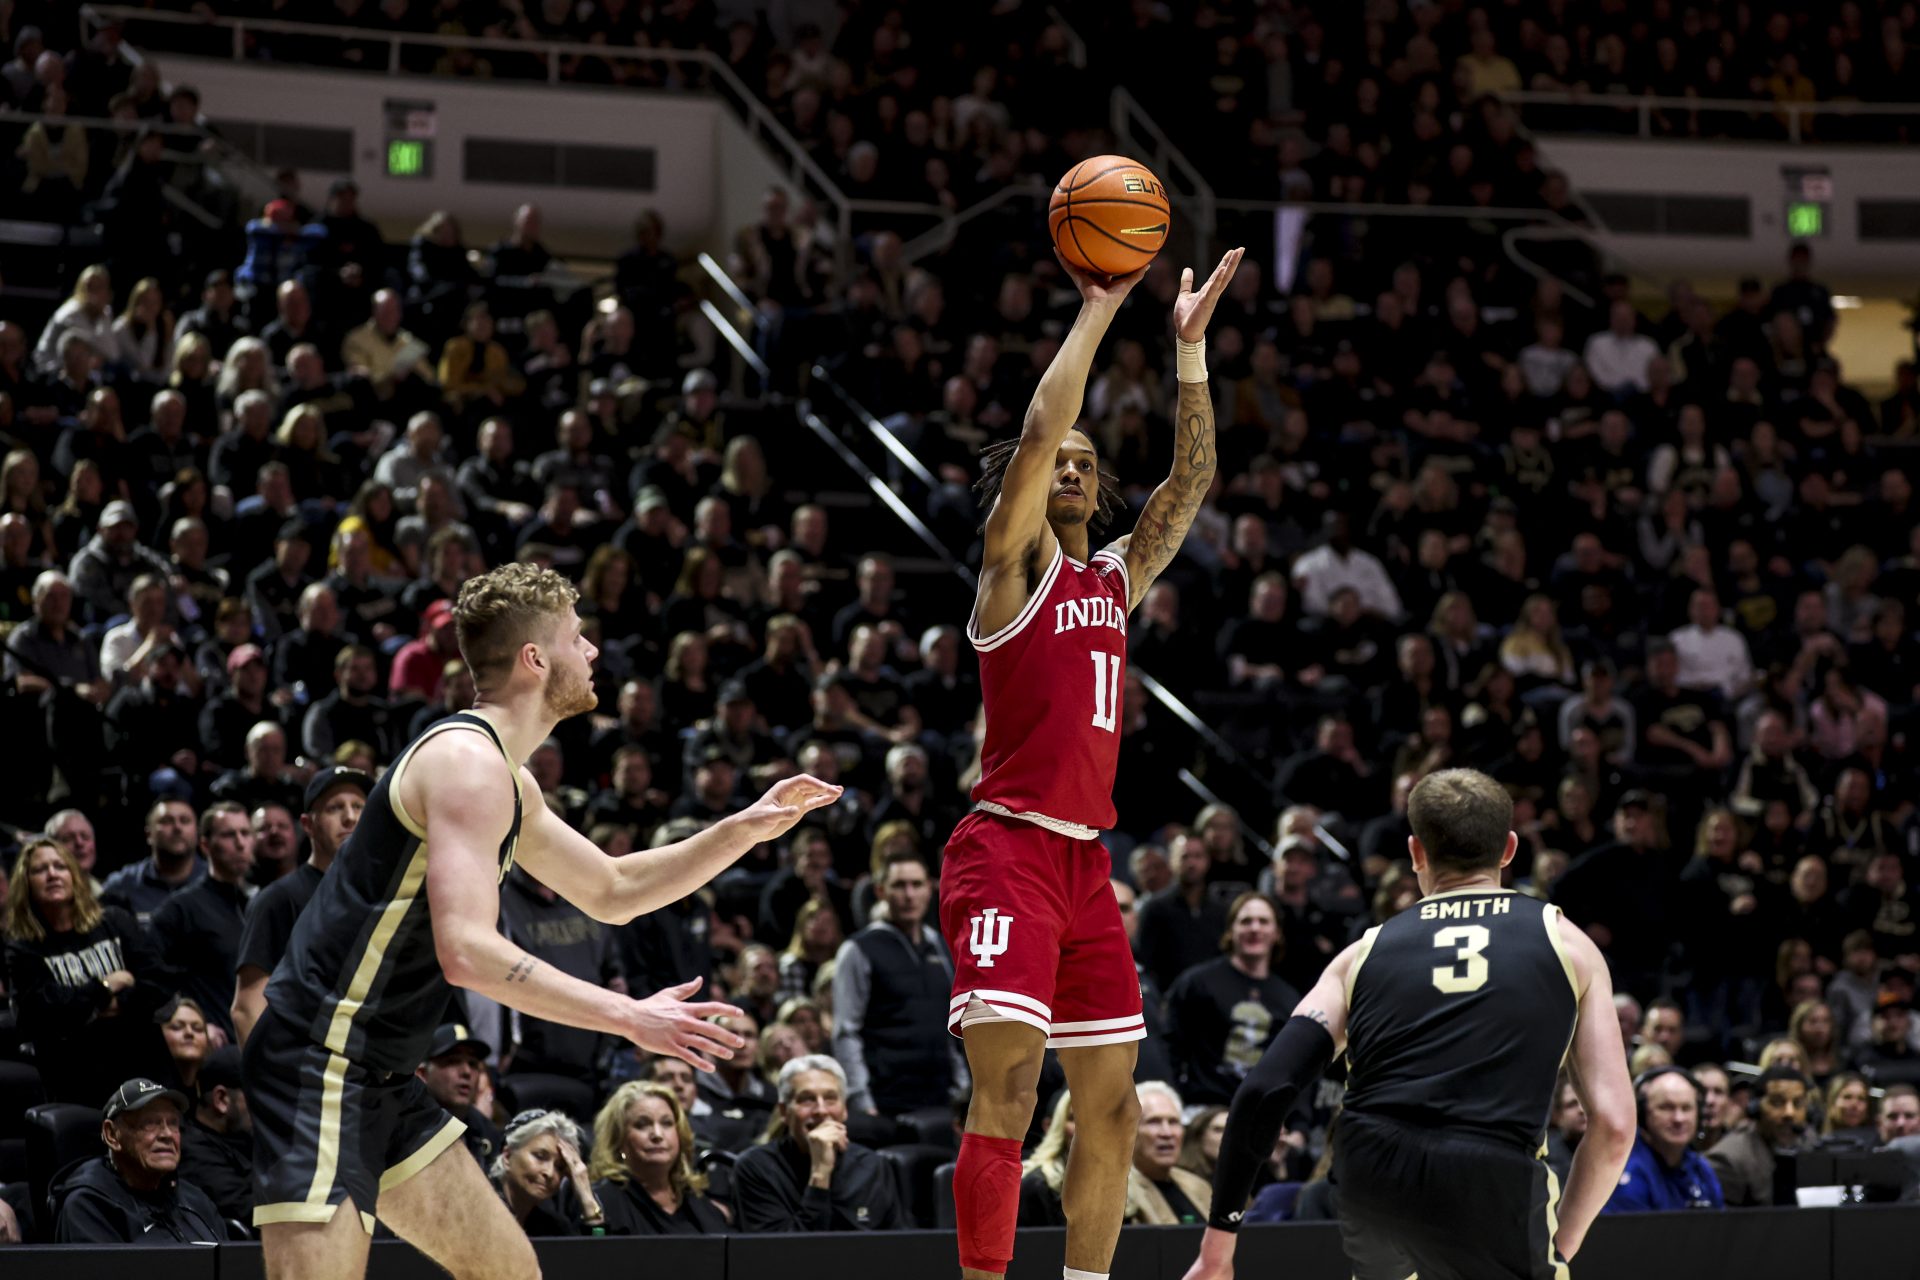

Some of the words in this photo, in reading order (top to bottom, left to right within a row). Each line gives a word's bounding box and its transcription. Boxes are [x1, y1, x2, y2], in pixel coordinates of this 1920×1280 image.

[1054, 596, 1126, 637] INDIA
[1090, 650, 1121, 733] 11
[1420, 897, 1511, 920] SMITH
[1432, 924, 1490, 995] 3
